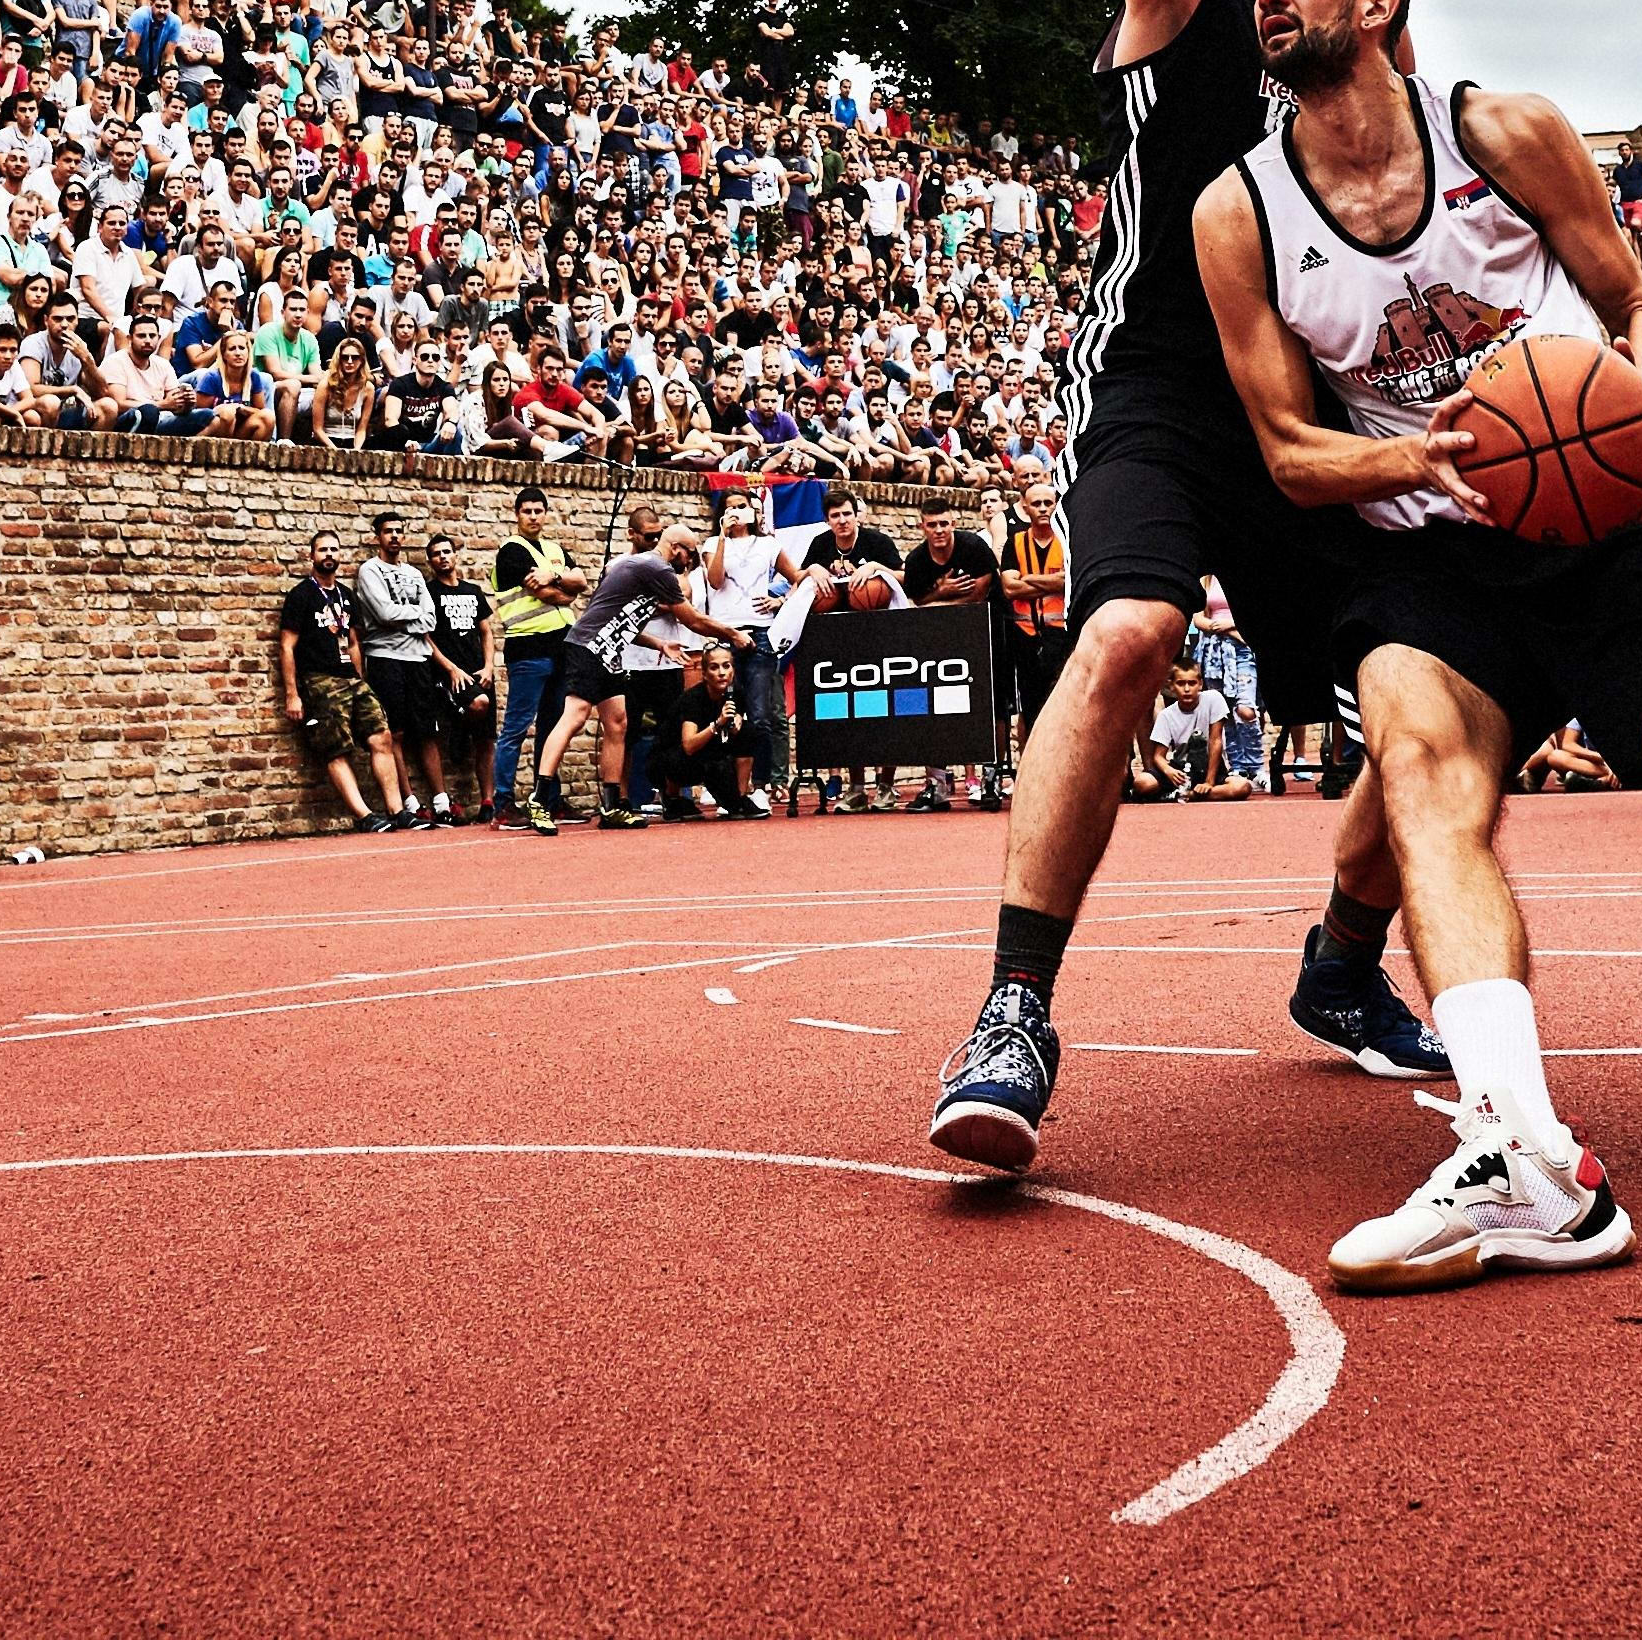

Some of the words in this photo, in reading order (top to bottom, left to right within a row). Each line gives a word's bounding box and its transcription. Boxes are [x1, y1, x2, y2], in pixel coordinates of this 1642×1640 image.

[1299, 258, 1329, 272] adidas
[1395, 331, 1454, 374] Bull
[813, 657, 970, 689] GoPro
